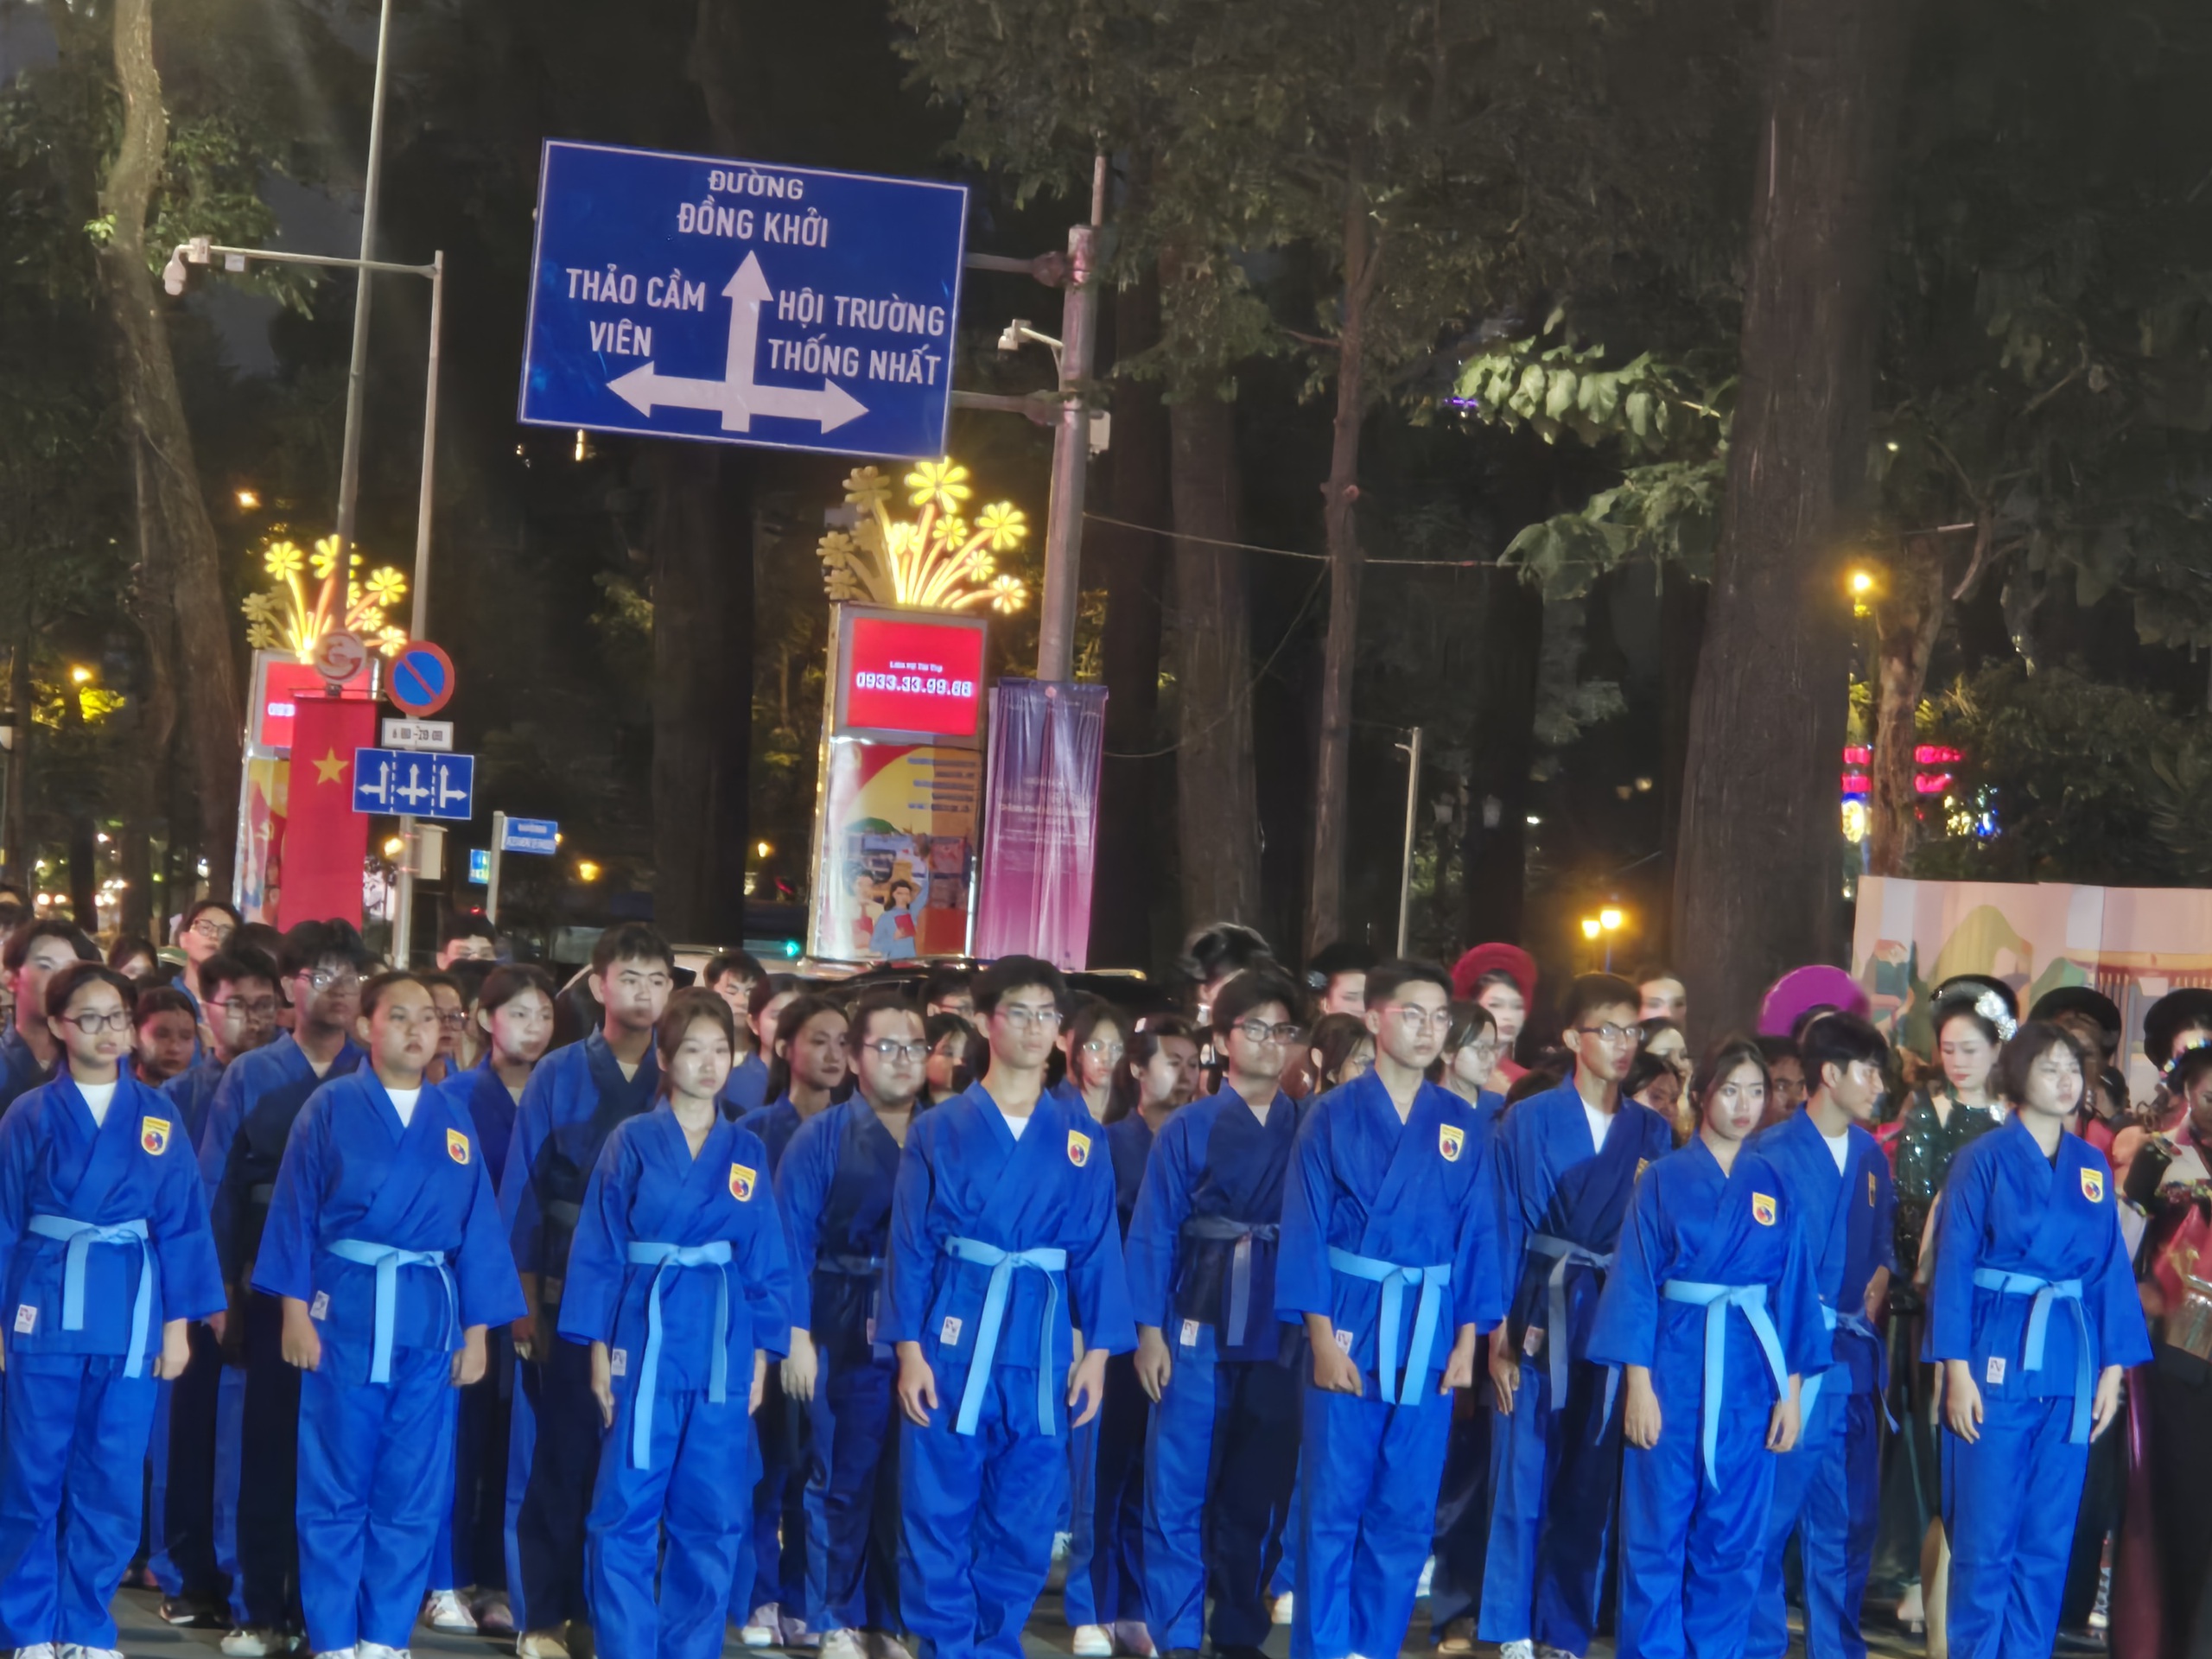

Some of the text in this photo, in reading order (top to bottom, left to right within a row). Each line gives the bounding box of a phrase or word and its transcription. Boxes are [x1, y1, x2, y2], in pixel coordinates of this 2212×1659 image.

[709, 168, 804, 200] ĐƯỜNG
[677, 194, 829, 248] ĐỒNG KHỞI
[566, 263, 707, 313] THẢO CẦM
[778, 286, 946, 337] HỘI TRƯỜNG
[589, 318, 652, 357] VIÊN
[768, 333, 942, 385] THỐNG NHẤT
